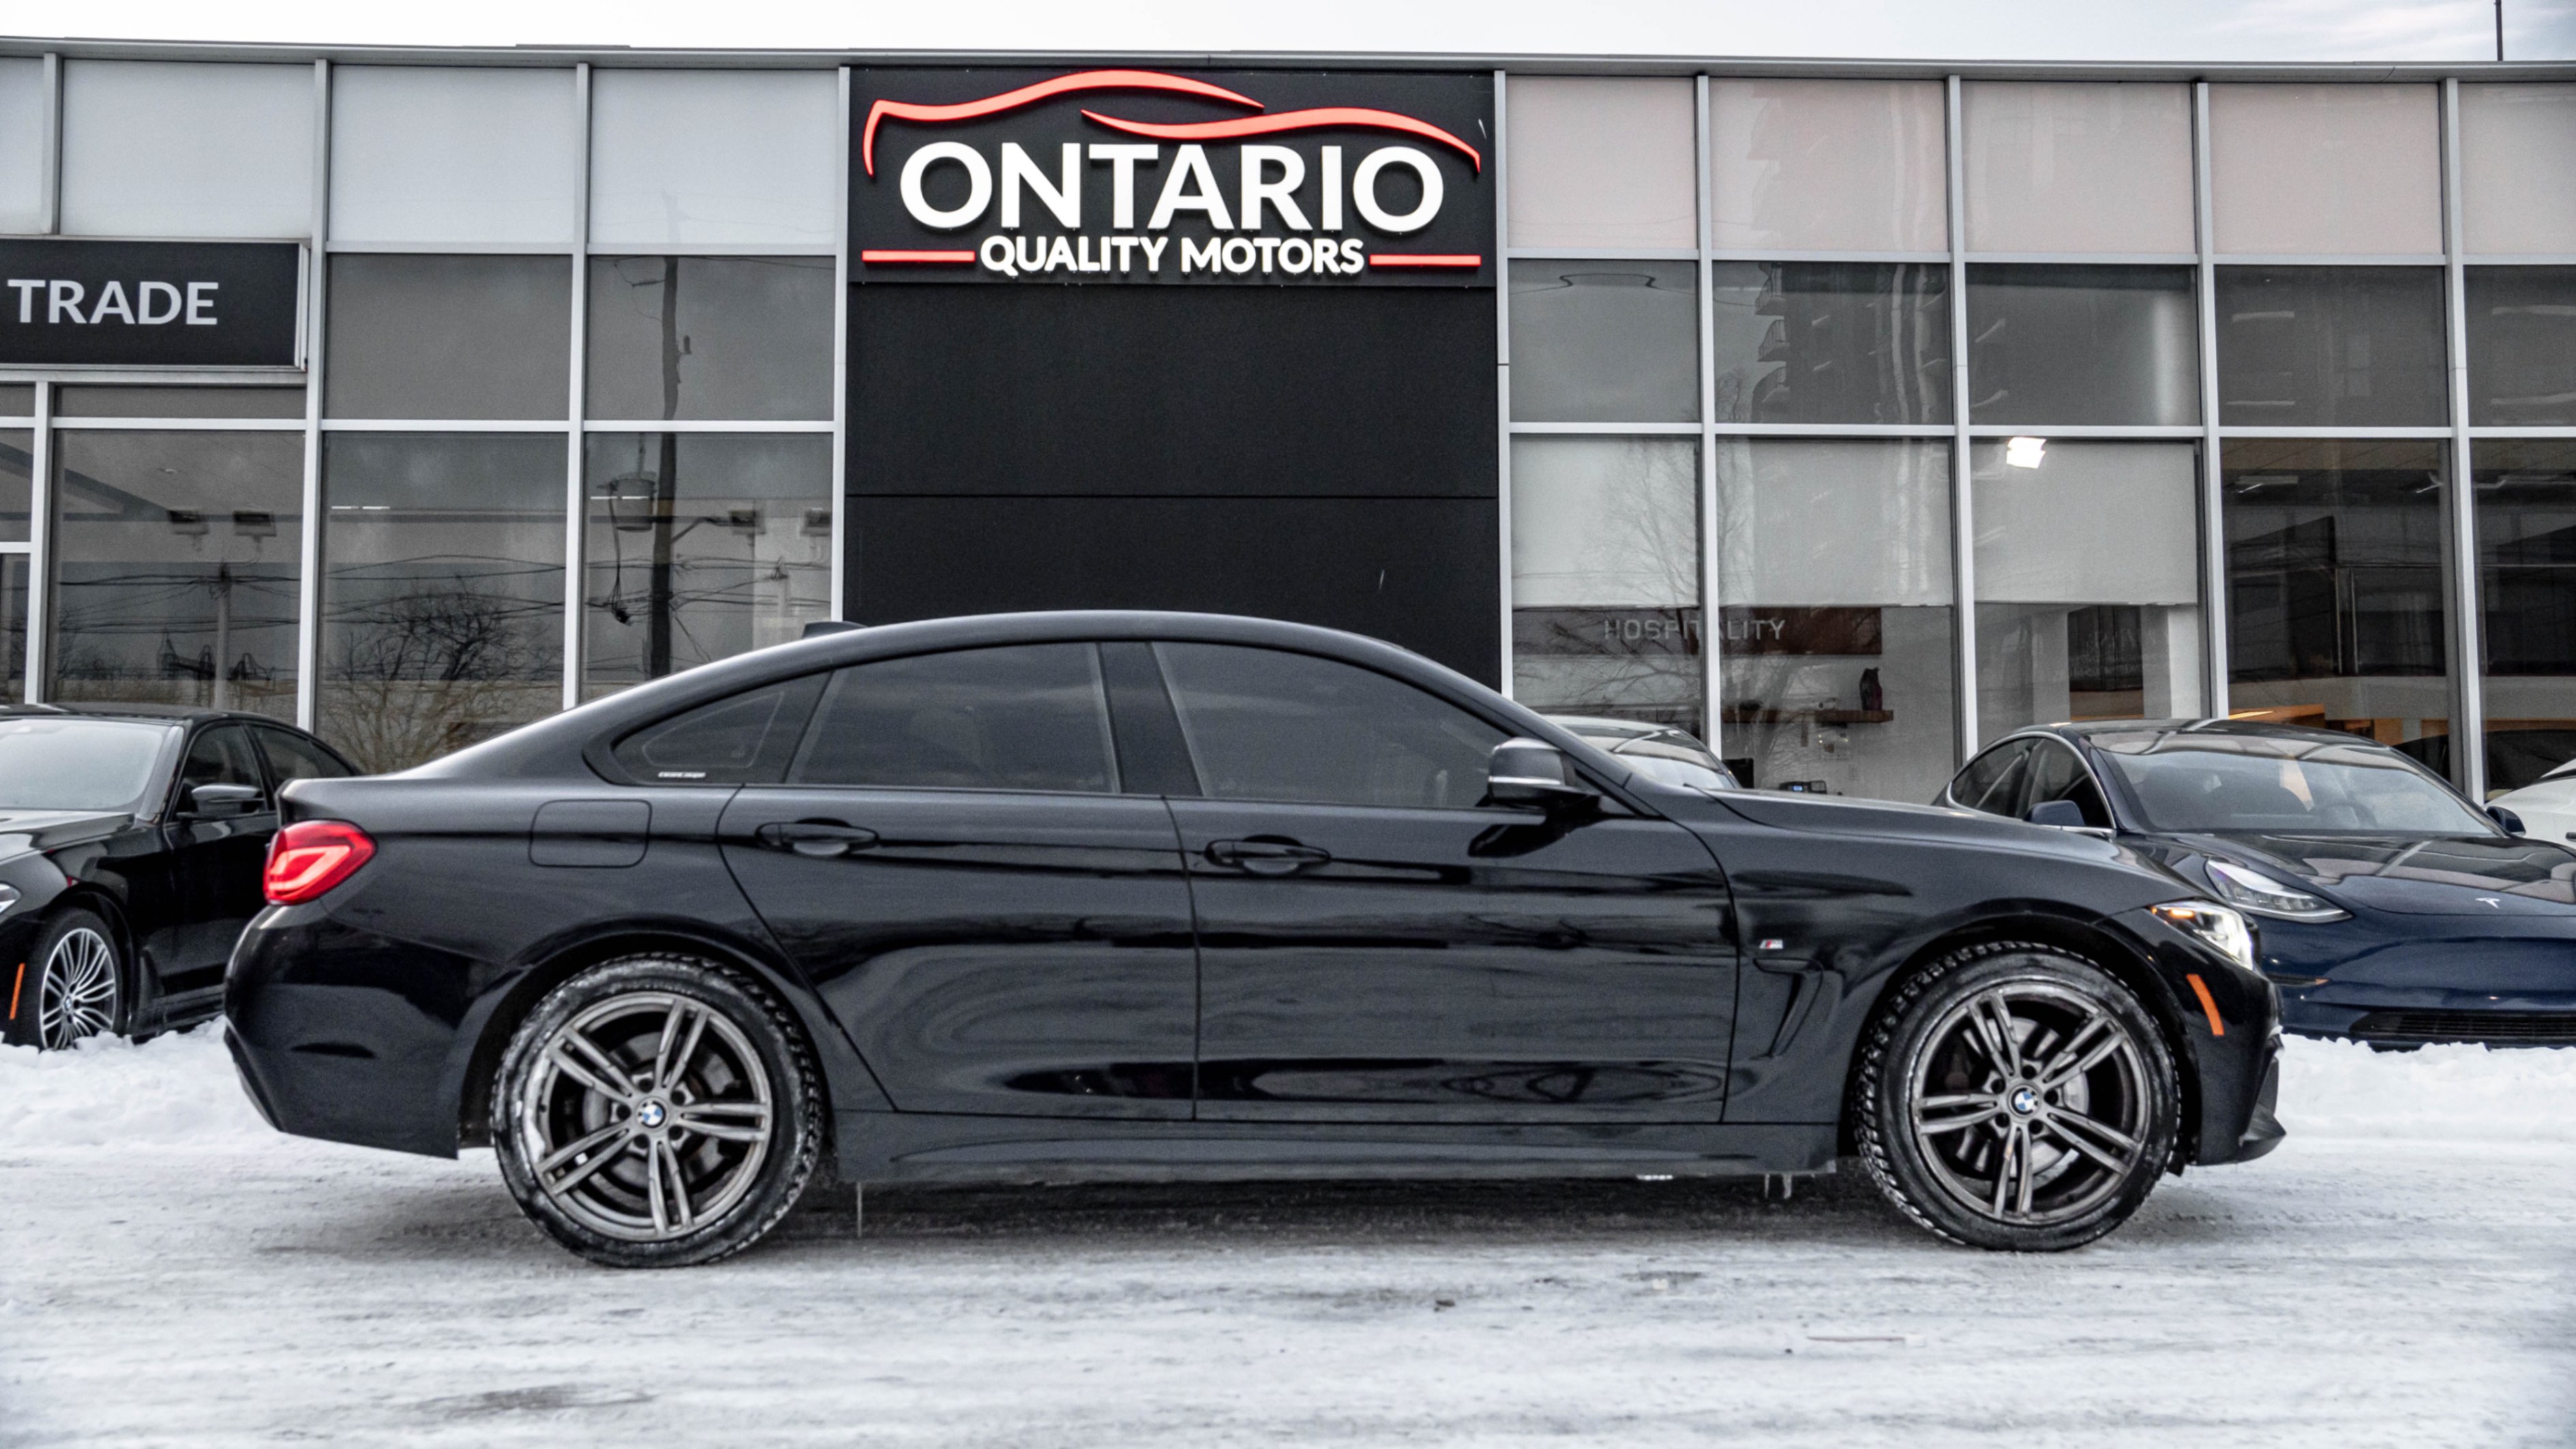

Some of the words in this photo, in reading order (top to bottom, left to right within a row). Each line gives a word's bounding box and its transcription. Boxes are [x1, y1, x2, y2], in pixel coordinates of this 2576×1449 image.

[900, 140, 1444, 233] ONTARIO
[979, 235, 1169, 277] QUALITY
[1180, 237, 1365, 274] MOTORS
[7, 279, 219, 325] TRADE
[1604, 618, 1785, 640] HOSPITLITY
